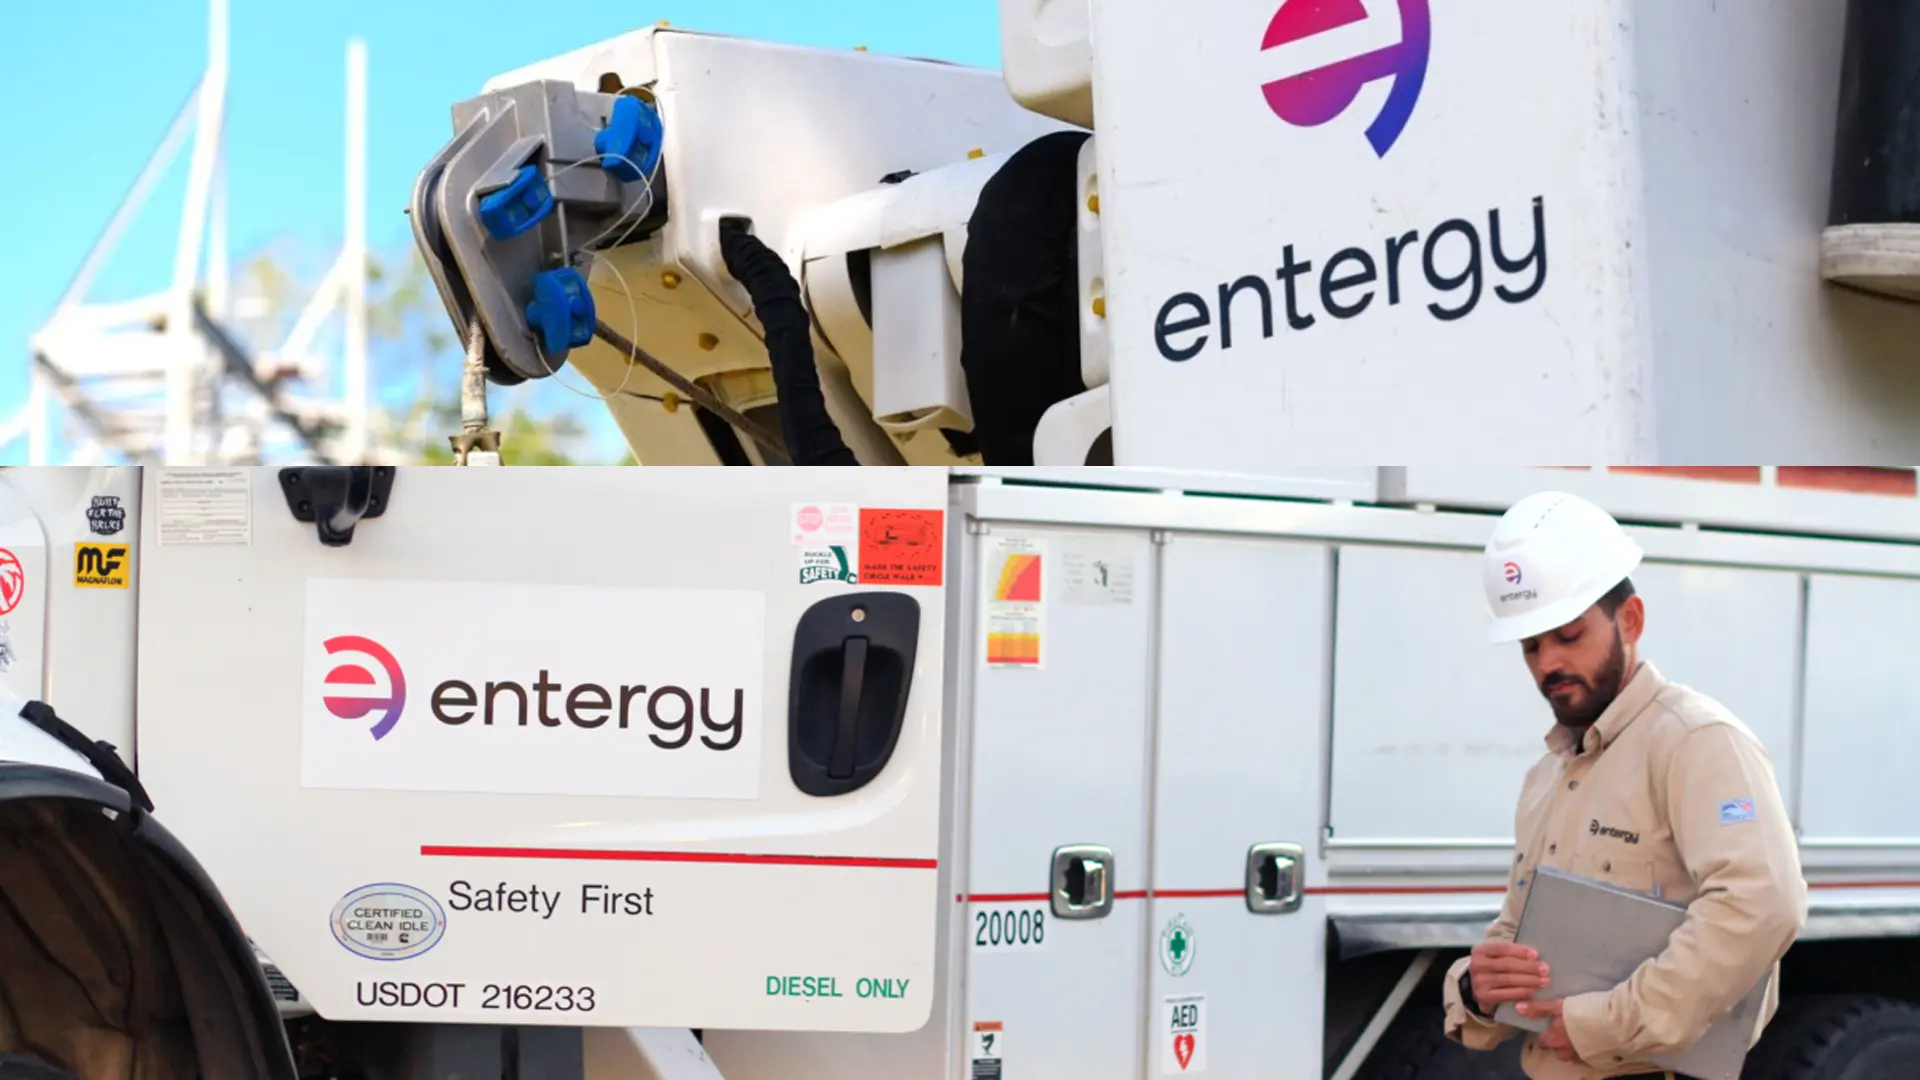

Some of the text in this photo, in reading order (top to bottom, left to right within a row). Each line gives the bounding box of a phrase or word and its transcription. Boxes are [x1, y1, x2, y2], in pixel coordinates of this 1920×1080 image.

[1154, 195, 1547, 362] entergy
[76, 575, 123, 585] MAGNAFLOW
[801, 566, 839, 583] SAFETY
[431, 669, 744, 751] entergy
[1599, 825, 1640, 845] entergy
[448, 880, 655, 919] Safety First
[353, 907, 423, 919] CERTIFIED
[346, 920, 429, 932] CLEAN IDLE
[975, 909, 1045, 946] 20008
[356, 982, 596, 1012] USDOT 216233
[766, 975, 910, 999] DIESEL ONLY
[1171, 1004, 1199, 1029] AED
